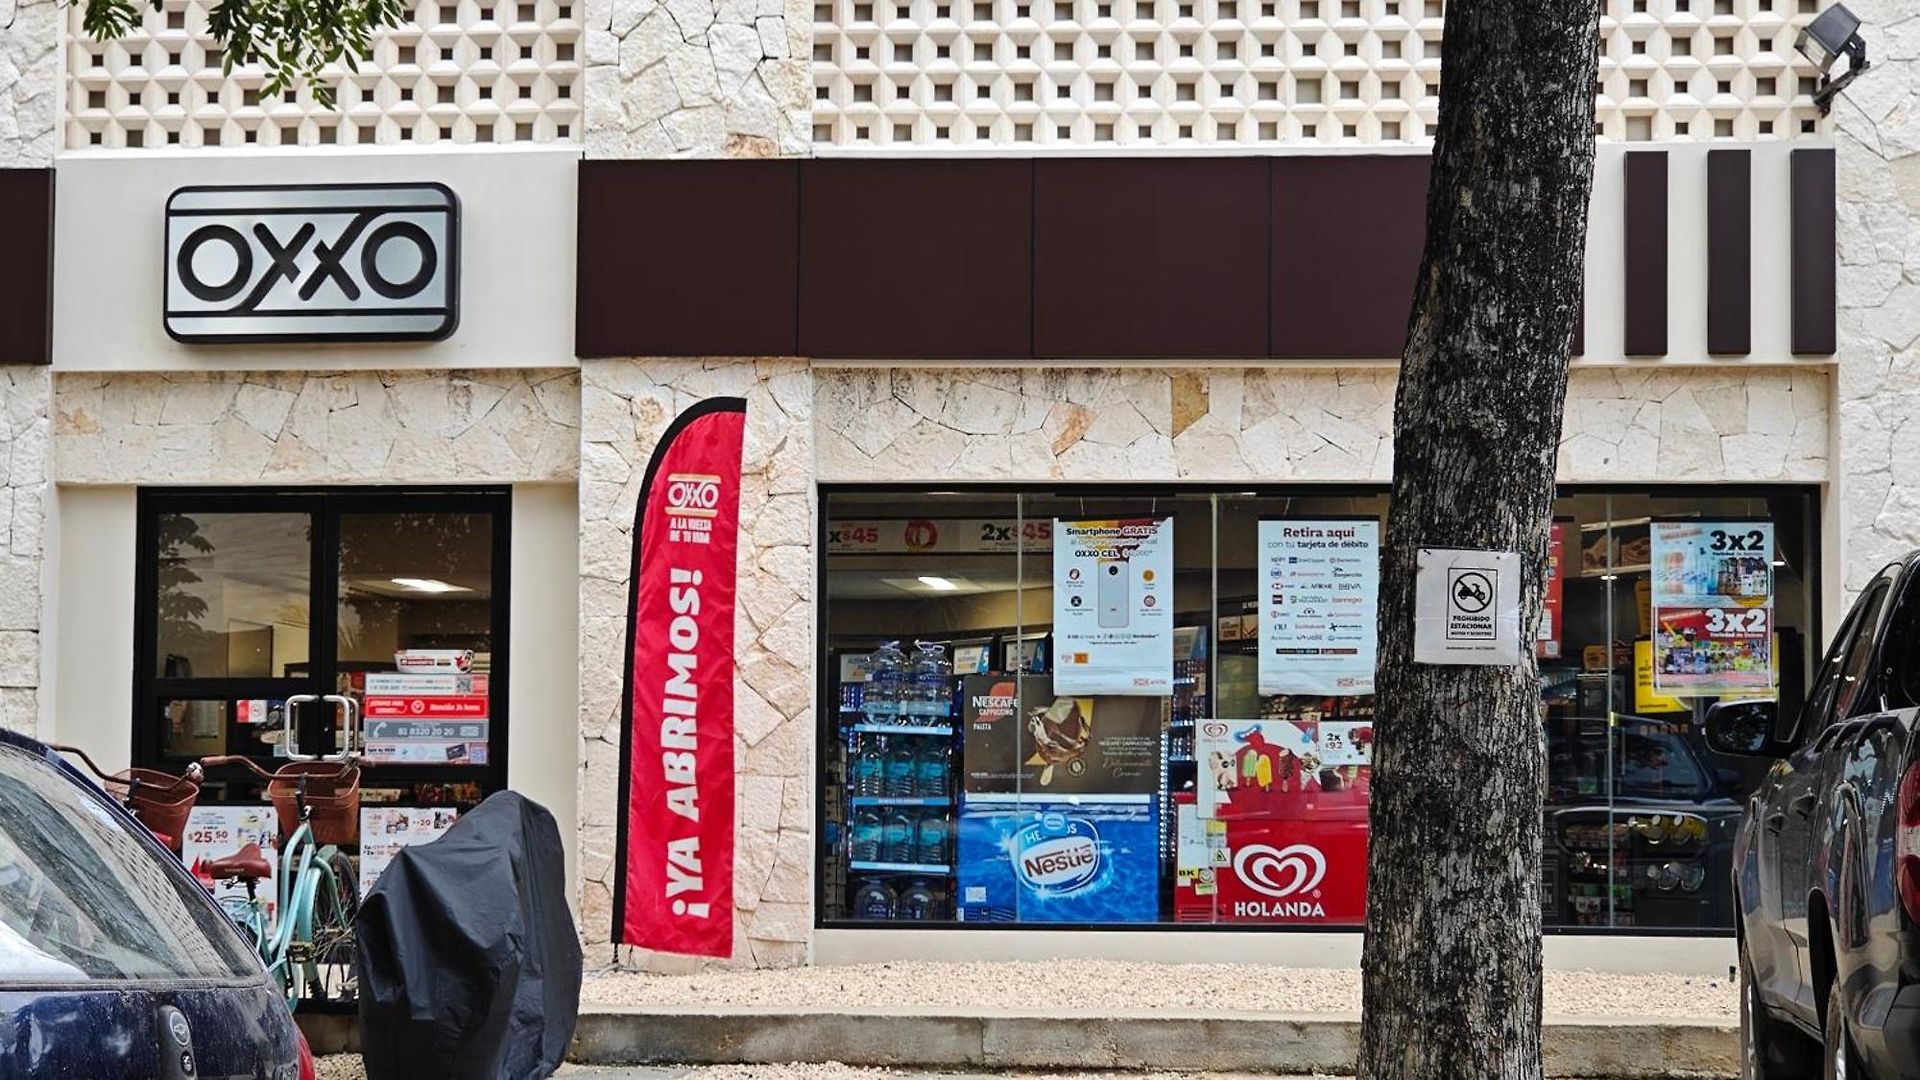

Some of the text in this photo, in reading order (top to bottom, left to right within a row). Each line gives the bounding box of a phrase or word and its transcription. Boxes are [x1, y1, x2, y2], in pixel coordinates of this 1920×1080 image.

[177, 219, 437, 303] OXXO
[667, 481, 719, 508] OXXO
[1066, 527, 1158, 536] Smartphone GRATIS
[1283, 527, 1323, 538] Retira
[1710, 530, 1765, 551] 3x2
[1075, 550, 1099, 558] OXXO
[1101, 549, 1117, 557] CEL
[1286, 541, 1295, 549] tu
[1297, 541, 1326, 550] tarjeta
[1328, 541, 1338, 549] de
[1705, 608, 1767, 633] 3x2
[661, 568, 711, 919] ¡YA ABRIMOS!
[1234, 901, 1326, 917] HOLANDA
